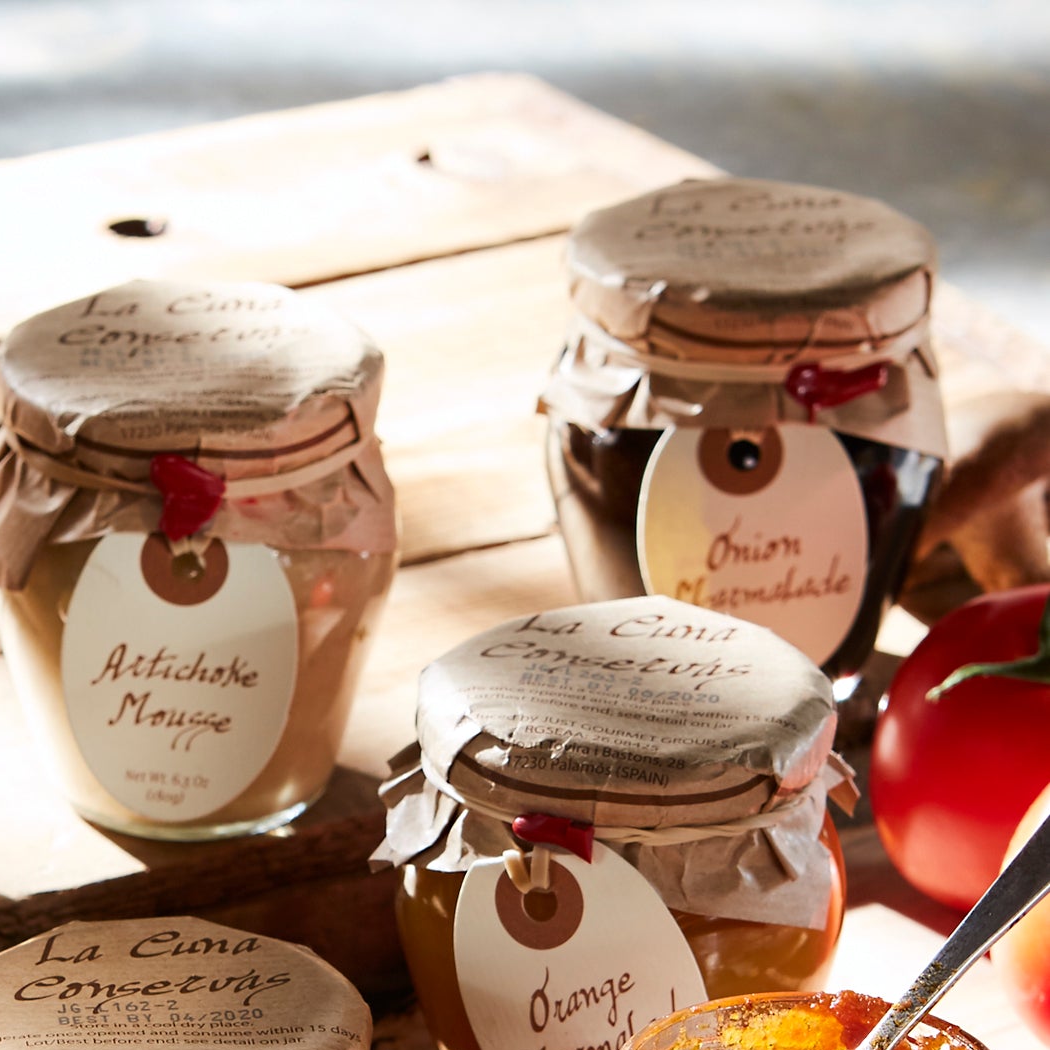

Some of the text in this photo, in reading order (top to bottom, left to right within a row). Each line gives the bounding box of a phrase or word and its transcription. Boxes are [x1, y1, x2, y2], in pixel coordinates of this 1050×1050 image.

[80, 294, 139, 318] La
[705, 515, 803, 572] Onion
[515, 613, 738, 643] La Cuna
[90, 642, 259, 688] Artichoke
[586, 679, 613, 691] BY
[107, 691, 233, 752] Mousse
[534, 695, 711, 730] before see detail on
[692, 709, 740, 722] within
[541, 715, 579, 729] JUST
[579, 723, 657, 744] GOURMET
[602, 746, 663, 769] Bastons,
[667, 756, 686, 771] 28
[615, 765, 671, 789] (SPAIN)
[35, 930, 263, 966] La Cuna
[529, 966, 637, 1034] Orange
[58, 1008, 264, 1026] BEST BY 04/2020
[144, 1020, 178, 1028] cool
[183, 1020, 206, 1030] dry
[208, 1019, 255, 1030] place.
[24, 1035, 307, 1048] Lot/Best before end: see detail on jar.
[44, 1030, 84, 1038] once
[86, 1028, 147, 1039] opened
[148, 1028, 180, 1037] and
[181, 1029, 253, 1038] consume
[255, 1025, 305, 1037] within
[308, 1023, 327, 1034] 15
